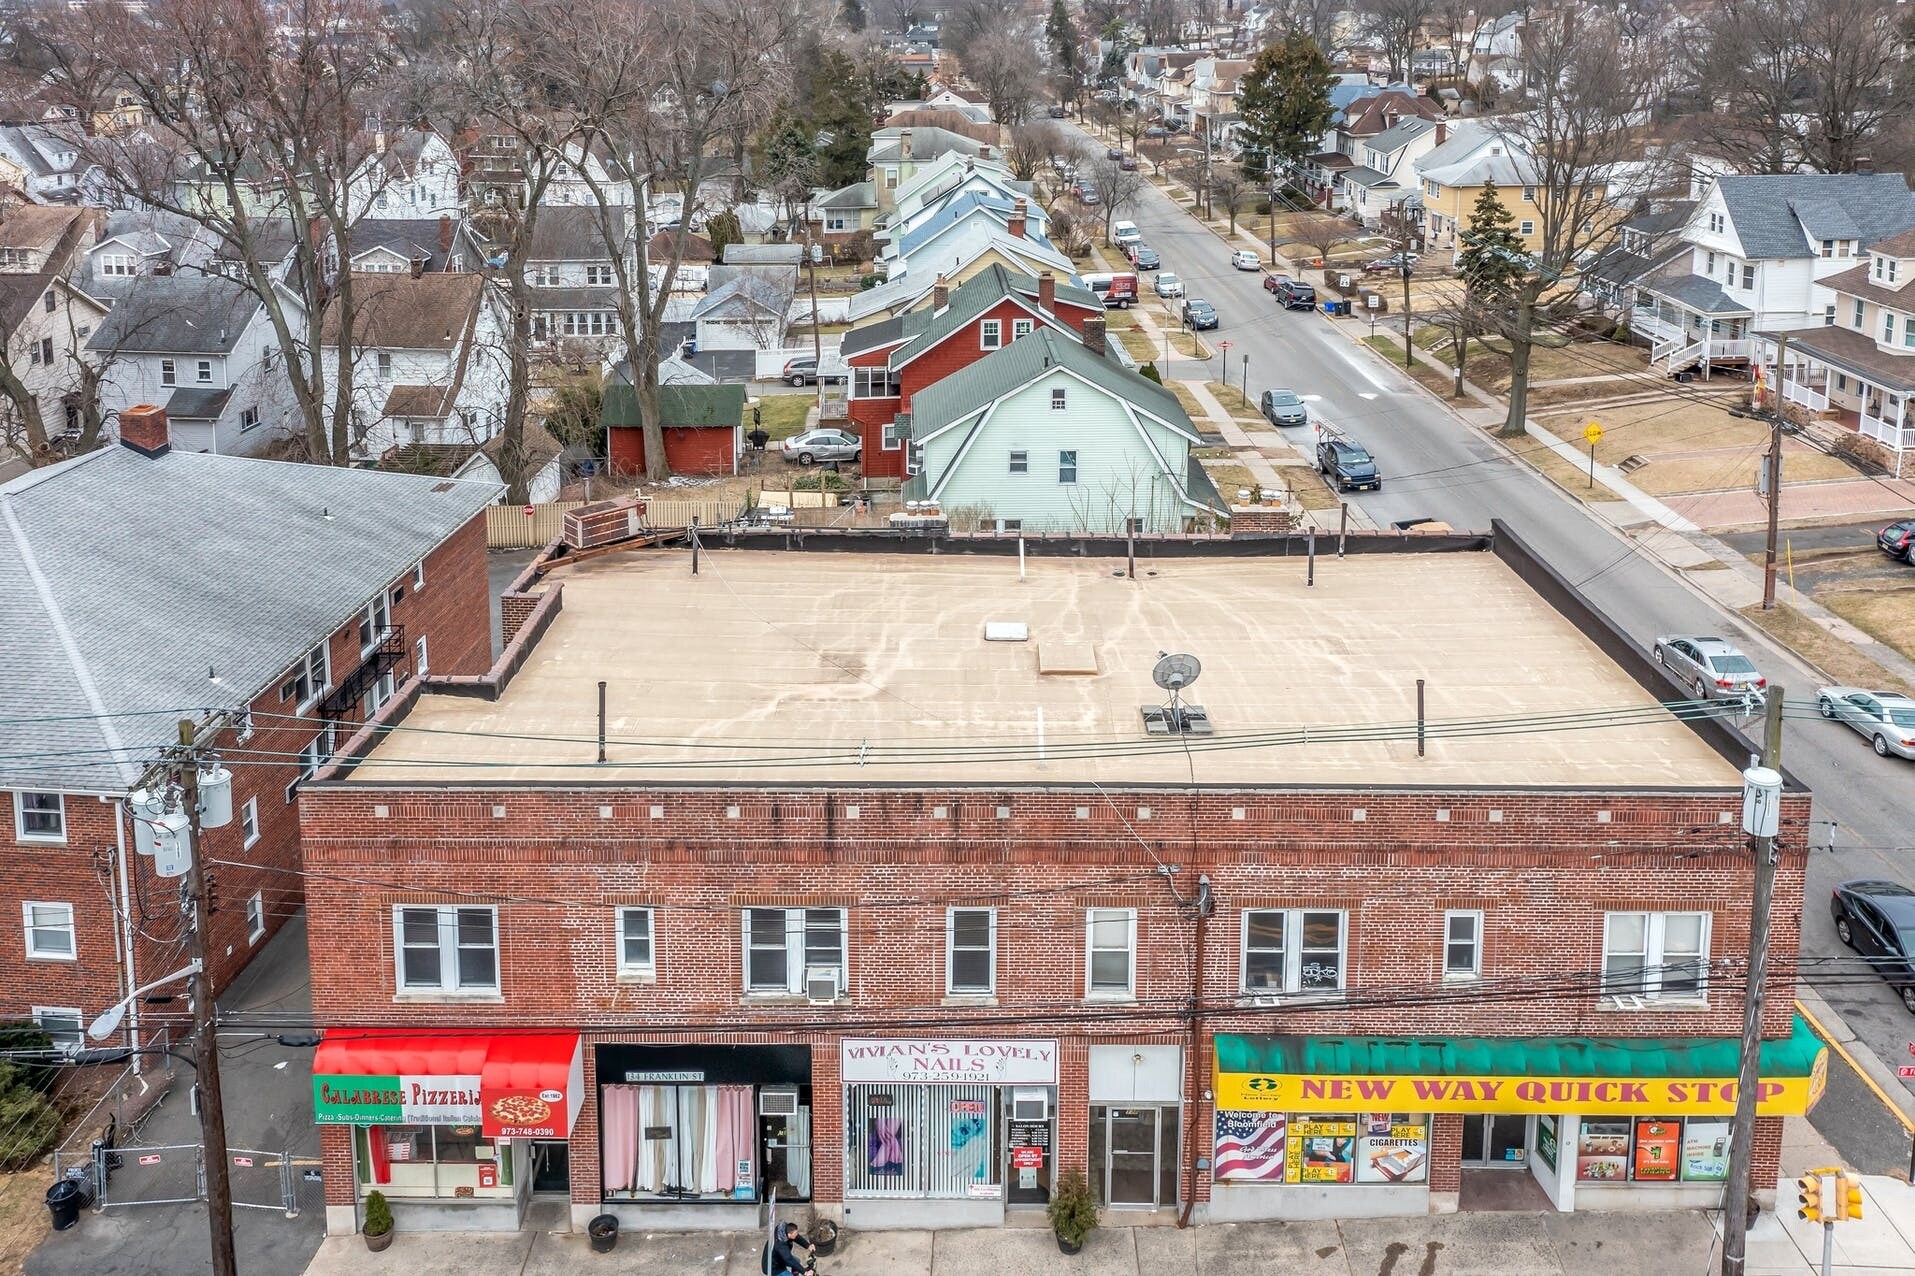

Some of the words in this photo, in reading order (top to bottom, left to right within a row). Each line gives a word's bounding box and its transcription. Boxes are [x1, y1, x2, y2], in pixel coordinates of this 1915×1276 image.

[848, 1042, 950, 1059] VIVIAN'S
[964, 1044, 1051, 1062] LOVELY
[913, 1057, 985, 1072] NAILS
[643, 1072, 689, 1080] FRANKLIN
[321, 1082, 406, 1105] CALABRESE
[1300, 1079, 1396, 1100] NEW
[1411, 1080, 1504, 1101] WAY
[1516, 1081, 1650, 1103] QUICK
[1667, 1082, 1785, 1103] STOP
[952, 1101, 985, 1113] OPEN
[318, 1112, 335, 1121] Pizza
[1224, 1111, 1266, 1120] Welcome
[1269, 1111, 1278, 1119] to
[501, 1127, 554, 1136] 973-748-0390
[1370, 1139, 1418, 1147] CIGARETTES
